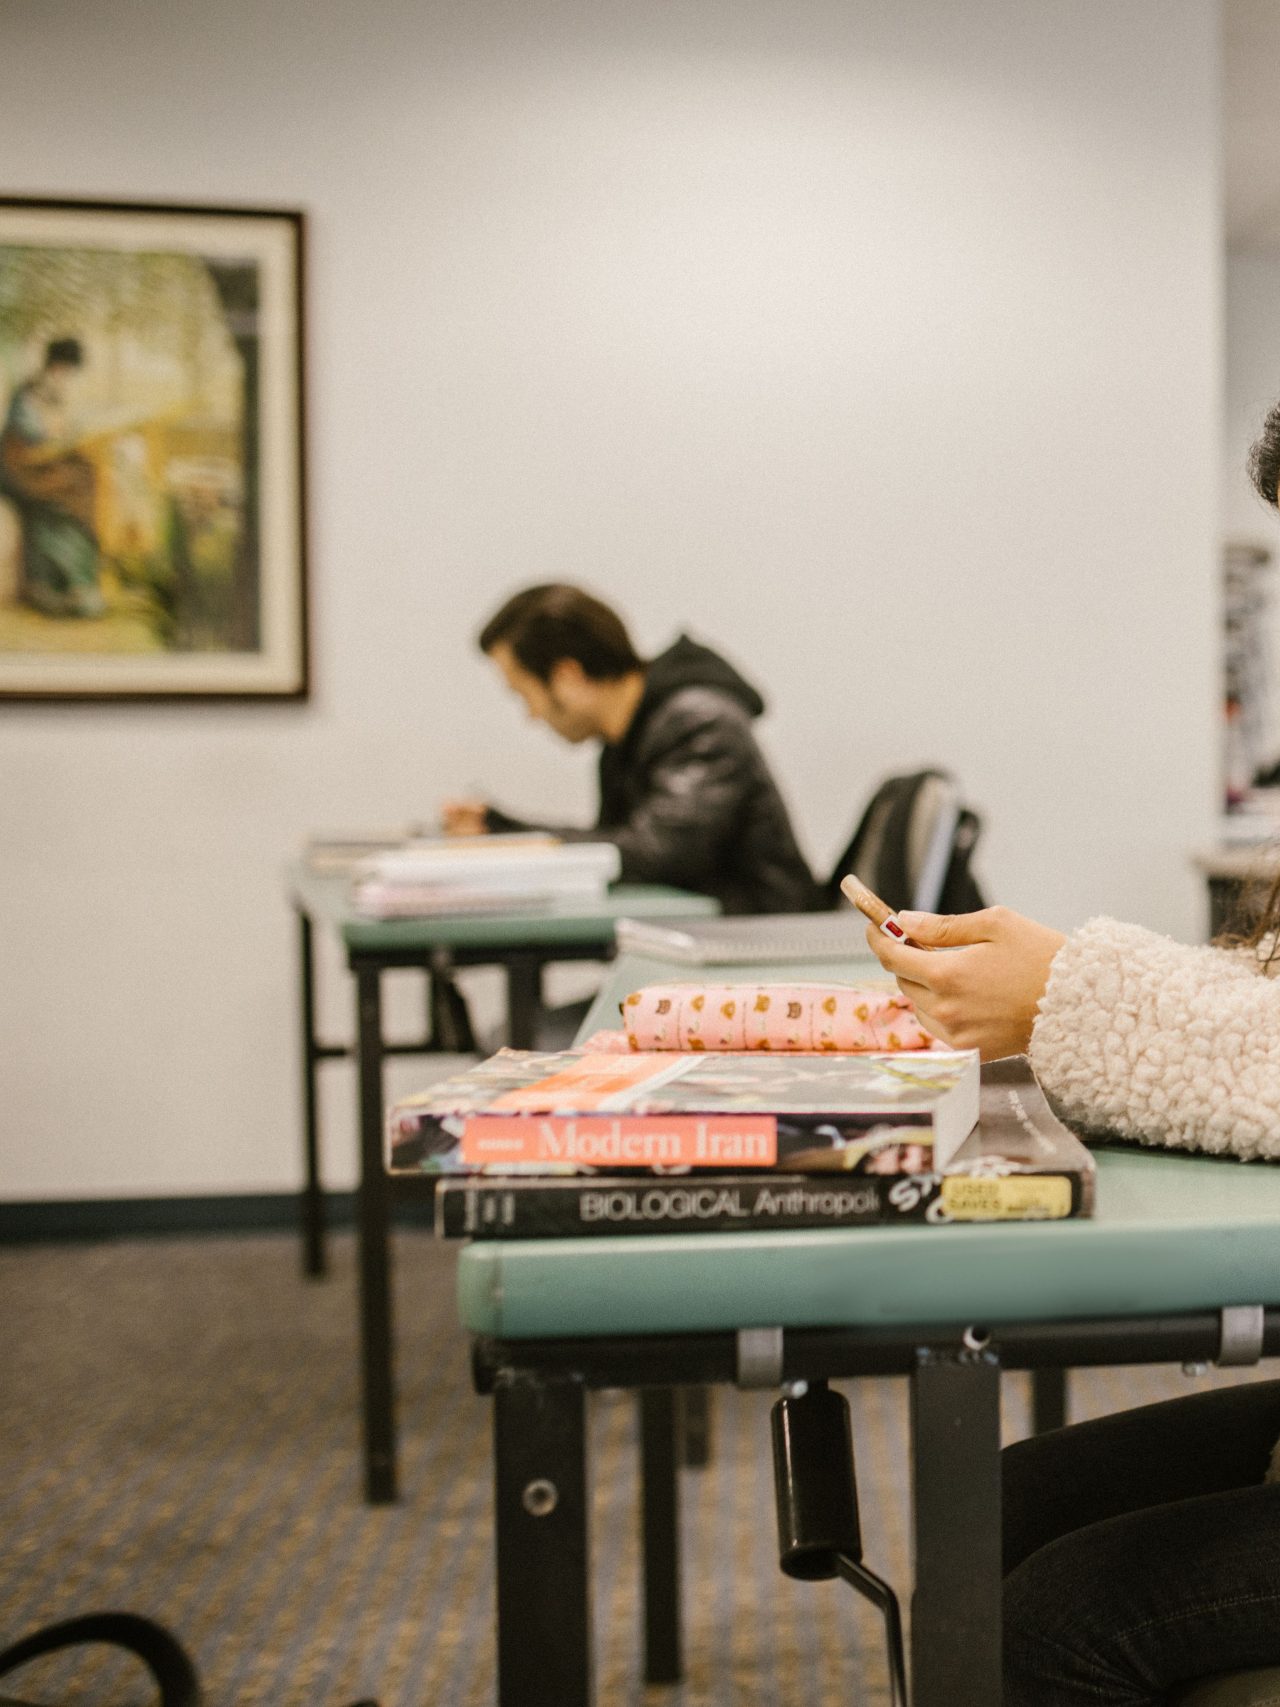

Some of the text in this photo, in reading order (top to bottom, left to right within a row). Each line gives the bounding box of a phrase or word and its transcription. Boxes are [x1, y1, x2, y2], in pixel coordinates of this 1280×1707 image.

[538, 1121, 681, 1158] Modern
[695, 1121, 768, 1158] Iran
[579, 1183, 879, 1222] BIOLOGICAL Anthropol
